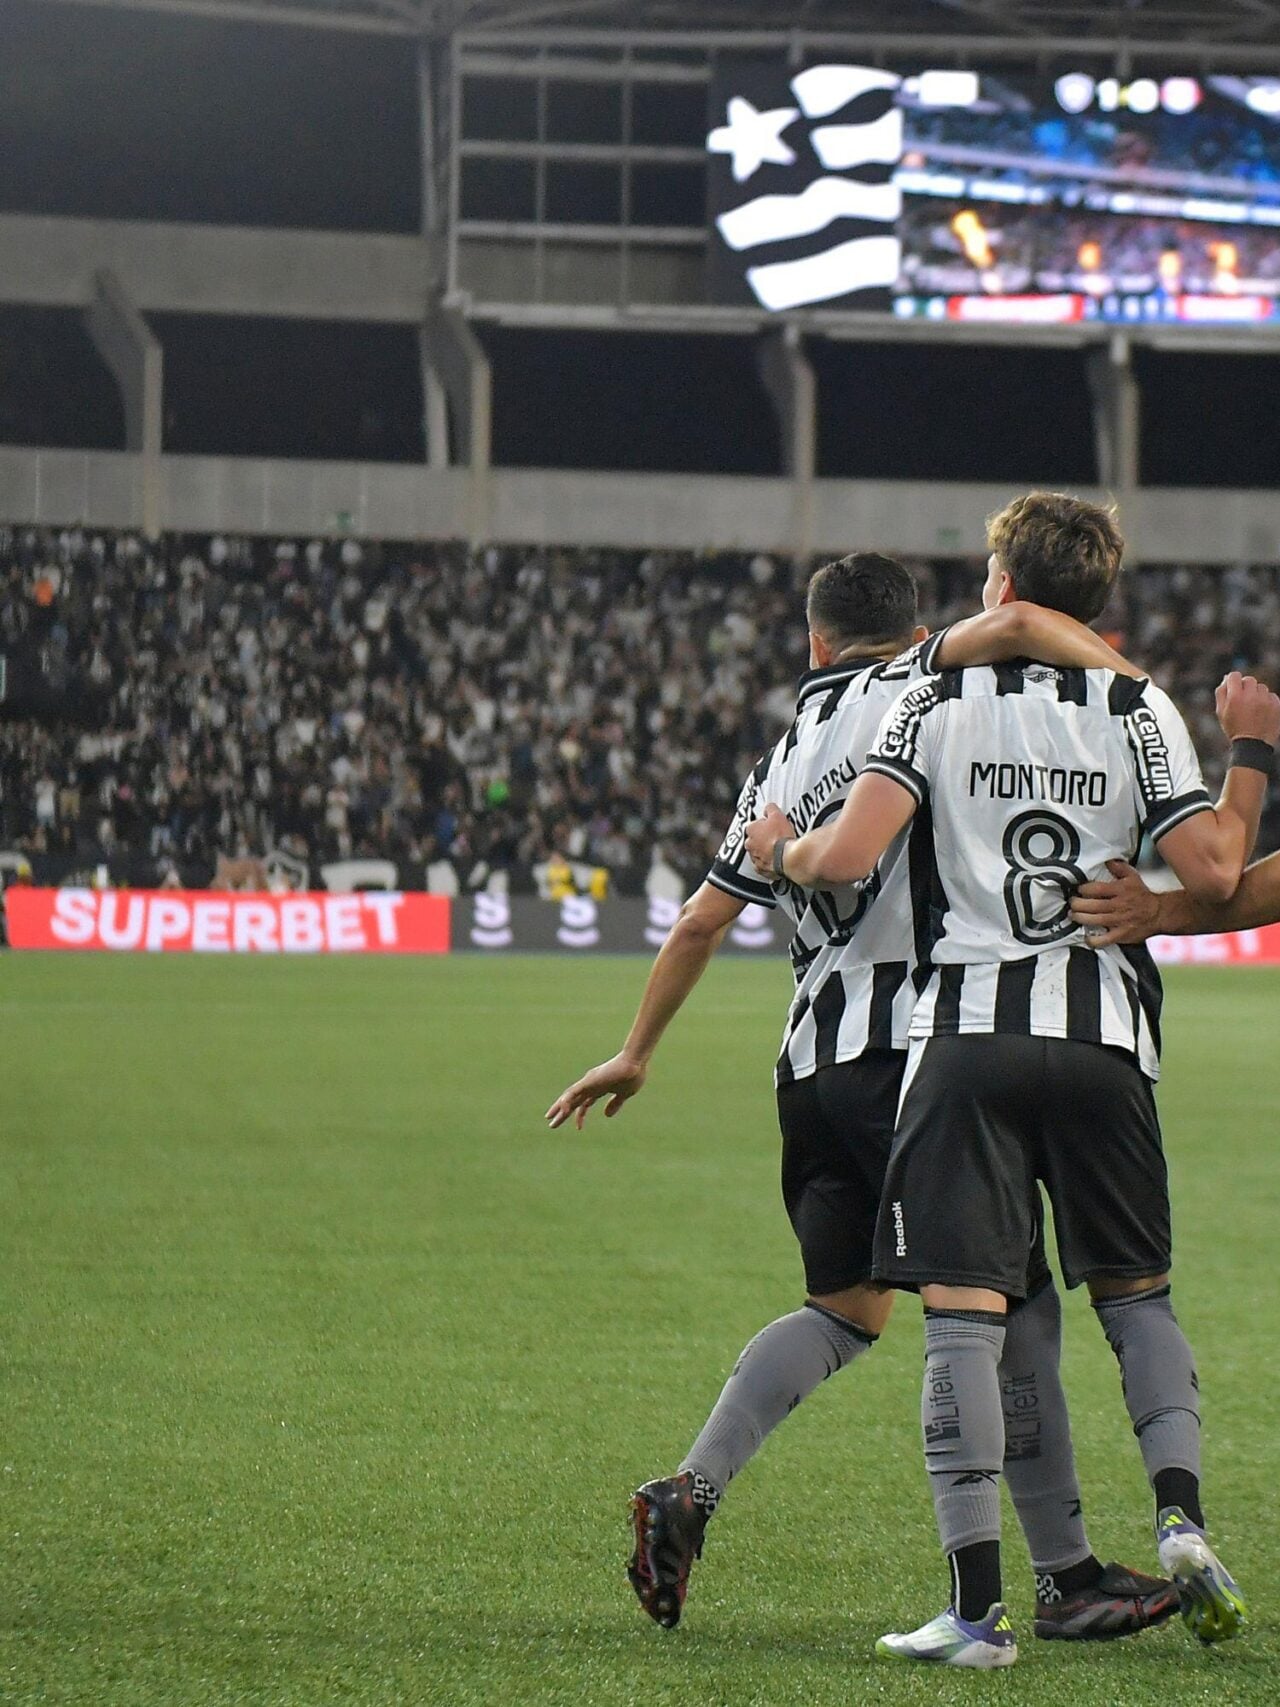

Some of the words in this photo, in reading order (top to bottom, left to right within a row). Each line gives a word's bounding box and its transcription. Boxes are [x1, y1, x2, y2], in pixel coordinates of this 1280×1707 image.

[969, 762, 1107, 806] MONTORO
[1133, 707, 1173, 800] Centrum
[1002, 809, 1089, 946] 8
[50, 887, 405, 952] SUPERBET
[892, 1200, 906, 1257] Reebok
